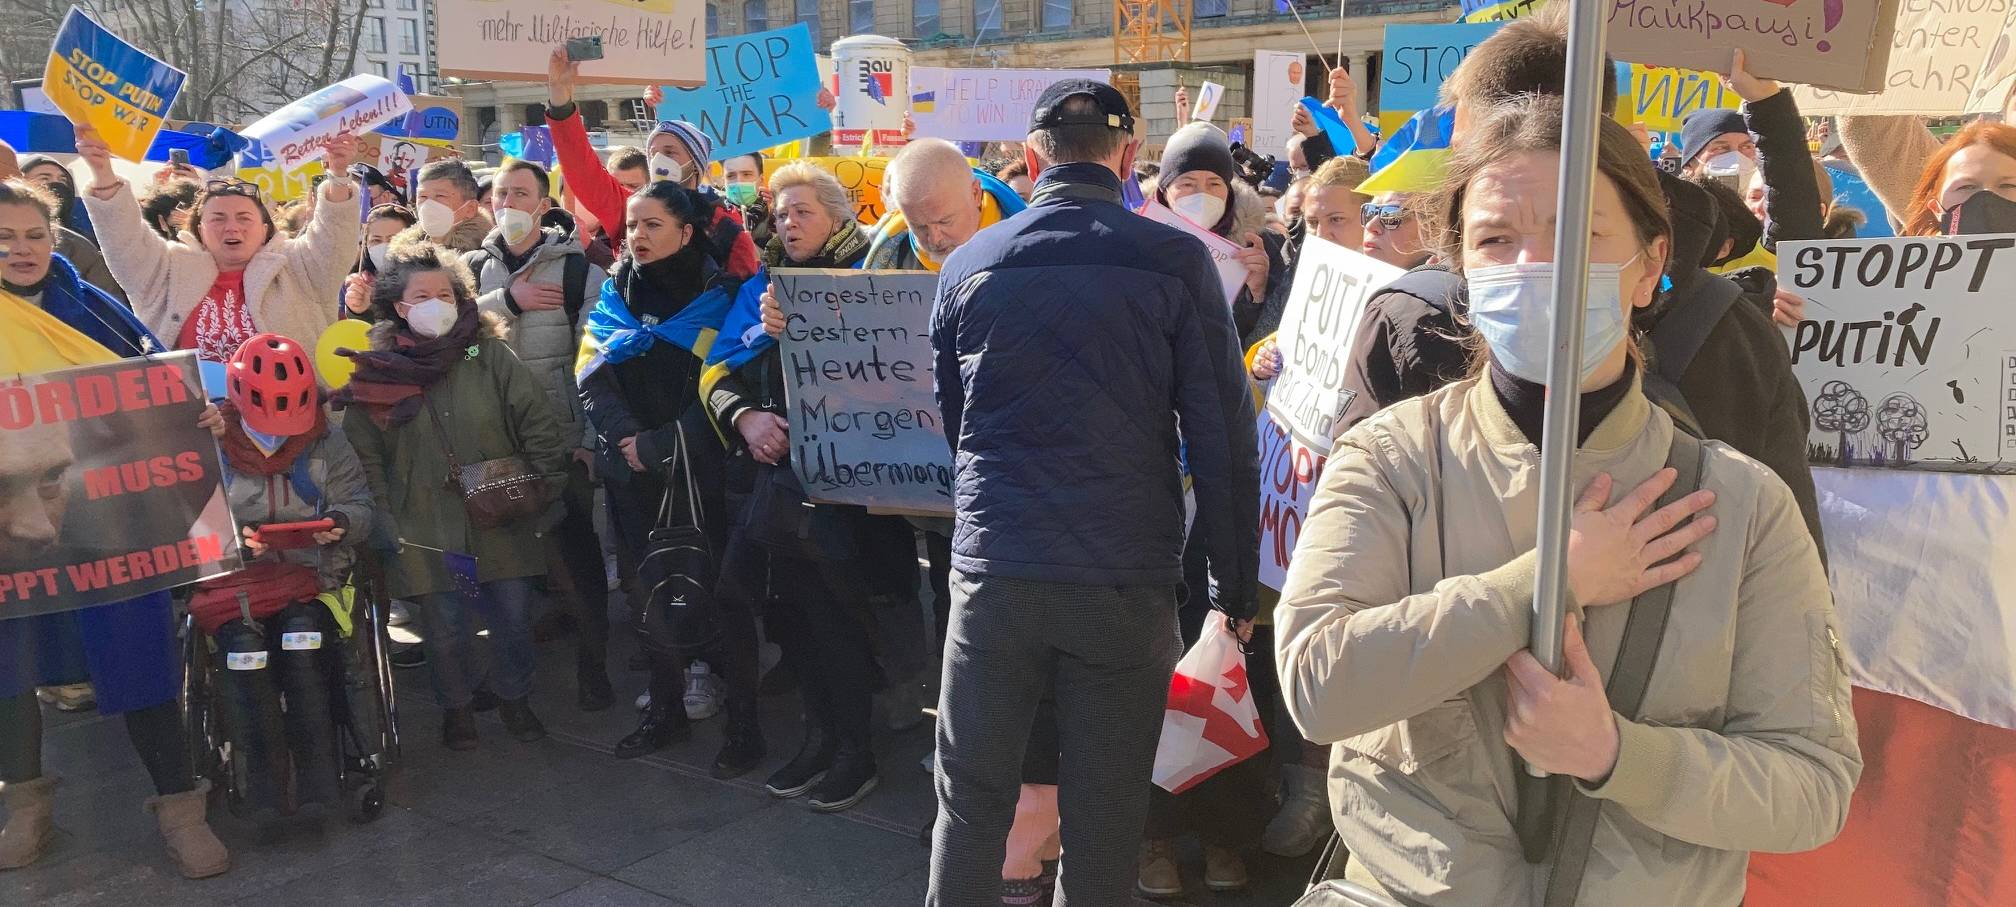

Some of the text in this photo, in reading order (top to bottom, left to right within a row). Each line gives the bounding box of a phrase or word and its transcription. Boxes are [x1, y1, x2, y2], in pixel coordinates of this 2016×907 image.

[482, 10, 523, 42] mehr
[68, 47, 164, 113] STOP PUTIN
[700, 36, 790, 87] TOP
[63, 69, 149, 132] STOP WAR
[715, 83, 756, 105] THE
[944, 78, 1052, 102] HELP UKRA
[423, 115, 459, 132] UTIN
[680, 94, 809, 147] WAR
[976, 103, 1005, 125] WIN
[280, 132, 332, 165] Retten
[1204, 243, 1228, 262] TOP
[1794, 238, 2016, 293] STOPPT
[778, 275, 923, 311] Vorgestern
[785, 313, 908, 347] Gestern
[791, 345, 915, 388] Heute
[1293, 322, 1340, 391] bomb
[0, 364, 187, 430] ÖRDER
[800, 395, 934, 441] Morgen
[1294, 382, 1334, 438] Zuha
[83, 450, 205, 501] MUSS
[0, 532, 224, 602] PPT WERDEN
